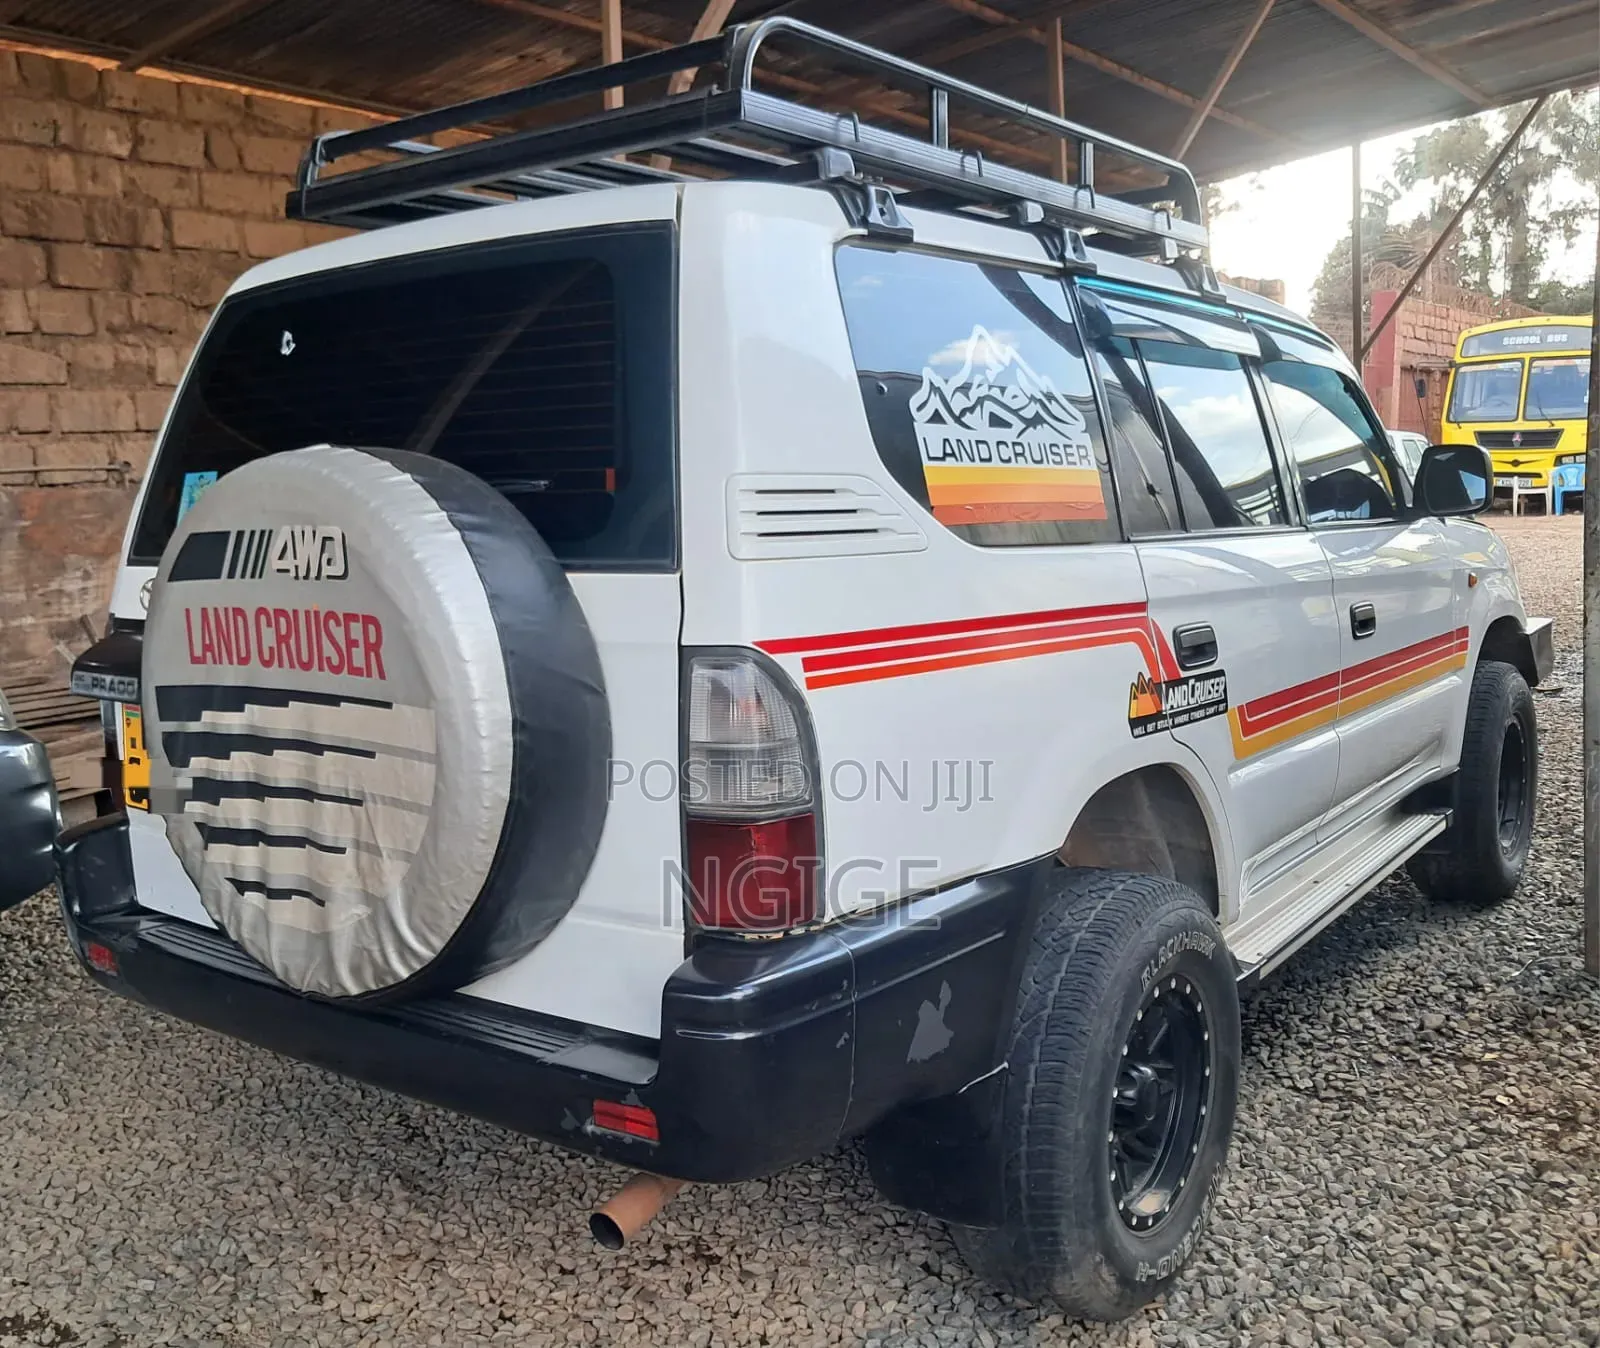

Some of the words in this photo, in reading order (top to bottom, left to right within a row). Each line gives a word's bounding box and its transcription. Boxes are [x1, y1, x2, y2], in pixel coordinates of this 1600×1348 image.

[1502, 335, 1541, 345] SCHOOL
[1546, 333, 1568, 343] BUS
[923, 436, 993, 464] LAND
[996, 440, 1092, 467] CRUISER
[271, 525, 350, 580] 4WD
[184, 606, 251, 666] LAND
[254, 604, 387, 681] CRUISER
[91, 675, 136, 697] PRADO
